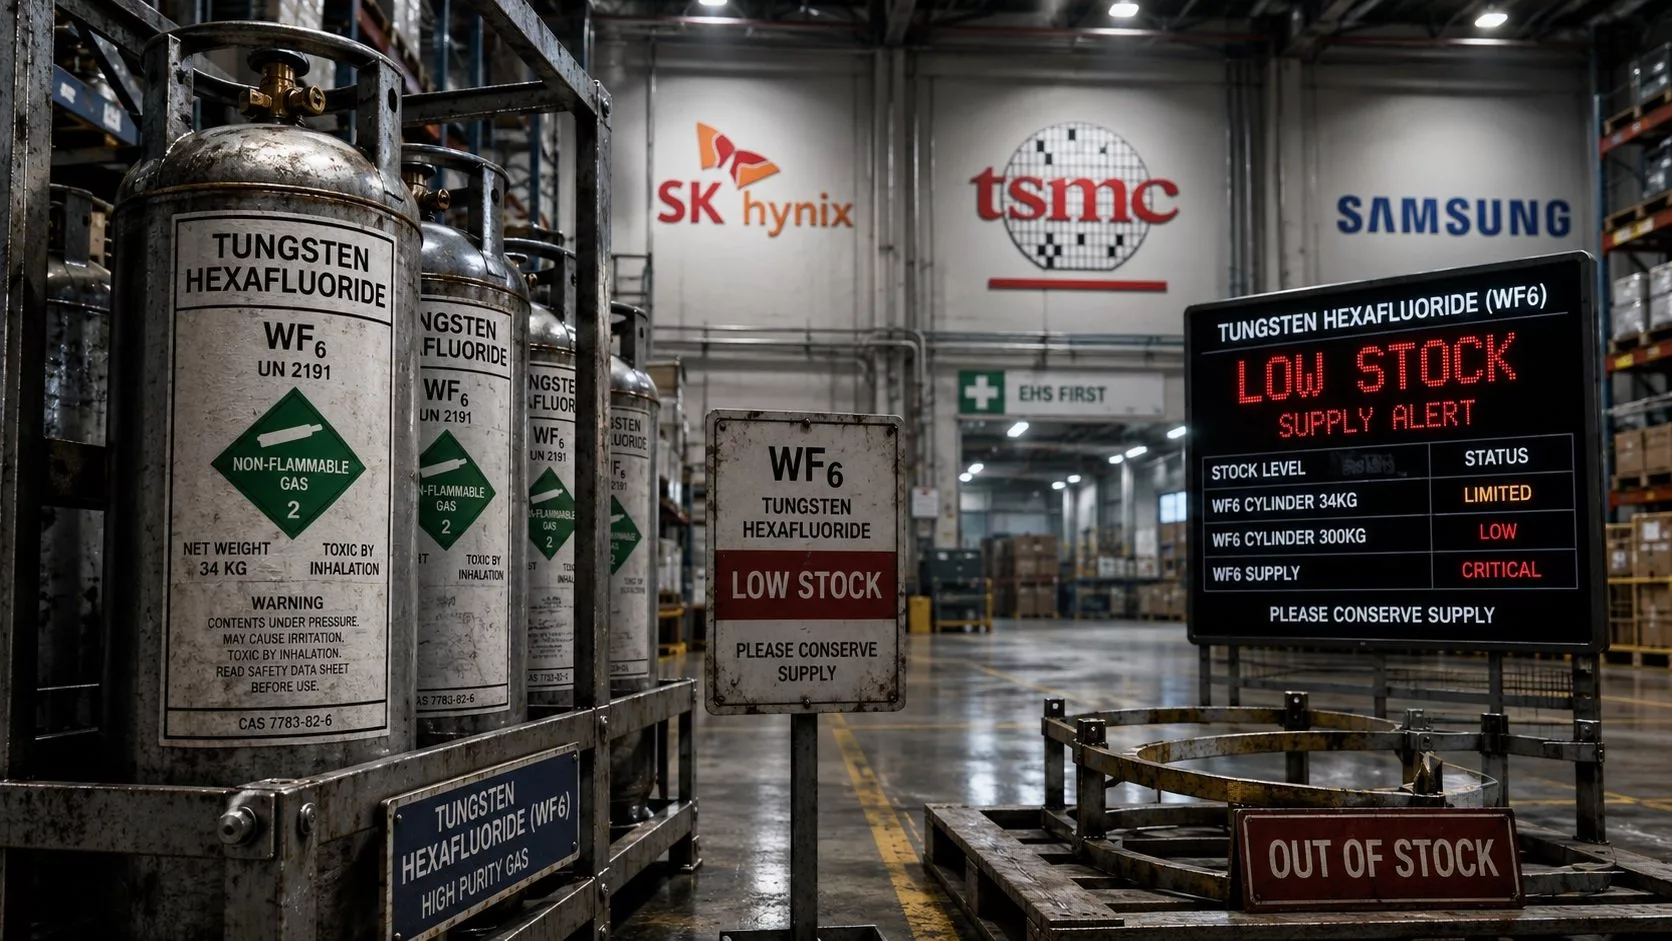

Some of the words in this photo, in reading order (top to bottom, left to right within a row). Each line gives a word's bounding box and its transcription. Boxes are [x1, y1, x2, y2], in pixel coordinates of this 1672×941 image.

[970, 166, 1179, 223] tsmc
[657, 180, 723, 223] SK
[744, 190, 853, 236] hynix
[1336, 195, 1567, 238] SAMSUNG
[212, 233, 369, 272] TUNGSTEN
[186, 266, 386, 308] HEXAFLUORIDE
[1218, 312, 1316, 342] TUNGSTEN
[1324, 292, 1478, 329] HEXAFLUORIDE
[1486, 283, 1546, 314] (WF6)
[421, 312, 496, 340] NGSTEN
[263, 322, 326, 358] WF6
[420, 337, 506, 366] FLUORIDE
[258, 361, 285, 377] UN
[292, 362, 330, 380] 2191
[1239, 352, 1323, 404] LOW
[1357, 332, 1516, 392] STOCK
[423, 378, 468, 407] WF6
[530, 374, 575, 395] NGSTE
[1019, 385, 1053, 402] EHS
[1059, 386, 1106, 402] FIRST
[420, 408, 439, 422] UN
[444, 410, 471, 424] 2191
[1280, 407, 1373, 438] SUPPLY
[1393, 399, 1475, 430] ALERT
[533, 426, 564, 449] WF6
[530, 450, 544, 461] UN
[547, 451, 566, 462] 2191
[1465, 447, 1528, 466] STATUS
[234, 457, 349, 474] NON-FLAMMABLE
[610, 460, 626, 479] F6
[768, 446, 843, 488] WF6
[1212, 463, 1257, 480] STOCK
[1263, 460, 1306, 477] LEVEL
[281, 476, 308, 491] GAS
[419, 485, 485, 498] N-FLAMMABLE
[1465, 485, 1531, 502] LIMITED
[288, 501, 299, 518] 2
[437, 501, 456, 511] GAS
[762, 497, 851, 515] TUNGSTEN
[1212, 498, 1240, 513] WF6
[1245, 495, 1314, 512] CYLINDER
[1320, 492, 1357, 508] 34KG
[442, 520, 450, 534] 2
[743, 521, 870, 539] HEXAFLUORIDE
[1480, 523, 1517, 539] LOW
[547, 536, 553, 548] 2
[1212, 532, 1240, 547] WF6
[1245, 530, 1314, 546] CYLINDER
[1320, 528, 1366, 544] 300KG
[184, 542, 210, 556] NET
[214, 542, 271, 555] WEIGHT
[323, 543, 357, 556] TOXIC
[361, 544, 374, 557] BY
[310, 561, 379, 575] INHALATION
[466, 554, 490, 565] TOXIC
[492, 555, 501, 565] BY
[200, 561, 218, 576] 34
[224, 561, 246, 575] KG
[459, 569, 503, 580] INHALATION
[1213, 567, 1241, 581] WF6
[1246, 566, 1300, 581] SUPPLY
[1462, 561, 1541, 578] CRITICAL
[733, 571, 789, 599] LOW
[798, 571, 882, 599] STOCK
[251, 596, 323, 610] WARNING
[208, 617, 264, 629] CONTENTS
[269, 617, 305, 628] UNDER
[309, 616, 359, 628] PRESSURE.
[1270, 606, 1328, 622] PLEASE
[1334, 606, 1422, 623] CONSERVE
[1428, 607, 1495, 623] SUPPLY
[223, 634, 245, 645] MAY
[249, 633, 285, 645] CAUSE
[288, 632, 344, 644] IRRITATION.
[227, 650, 259, 661] TOXIC
[263, 649, 276, 660] BY
[281, 648, 341, 660] INHALATION.
[737, 642, 793, 658] PLEASE
[799, 642, 877, 658] CONSERVE
[216, 666, 244, 679] READ
[248, 665, 288, 677] SAFETY
[291, 664, 316, 676] DATA
[319, 663, 349, 675] SHEET
[778, 665, 836, 682] SUPPLY
[251, 681, 293, 693] BEFORE
[297, 680, 319, 692] USE.
[417, 695, 429, 708] AS
[239, 717, 265, 730] CAS
[269, 714, 332, 729] 7783-82-6
[435, 780, 515, 833] TUNGSTEN
[402, 808, 526, 885] HEXAFLUORIDE
[530, 791, 570, 833] (WF6)
[1269, 839, 1331, 878] OUT
[1343, 839, 1382, 878] OF
[1394, 838, 1499, 877] STOCK
[422, 881, 456, 920] HIGH
[459, 858, 503, 901] PURITY
[505, 848, 528, 876] GAS
